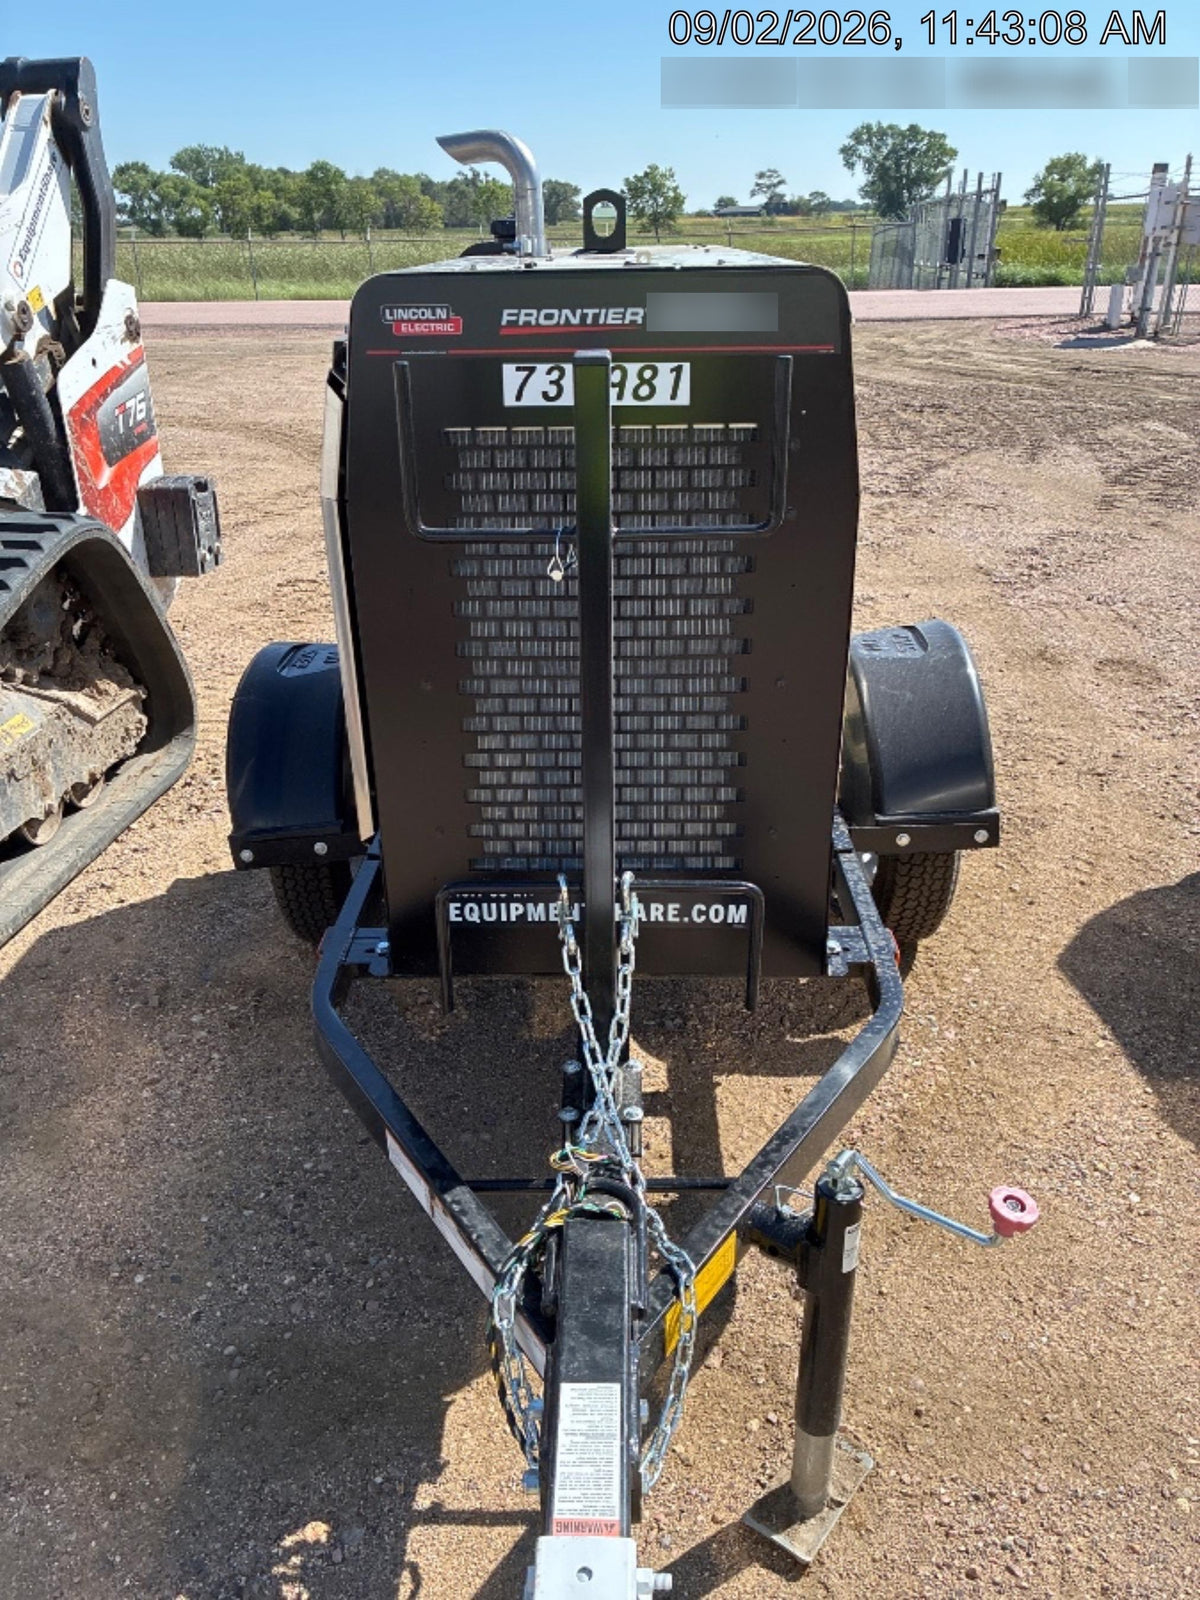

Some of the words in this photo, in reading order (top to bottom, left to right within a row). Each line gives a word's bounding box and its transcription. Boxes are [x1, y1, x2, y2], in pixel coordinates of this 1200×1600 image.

[19, 150, 58, 263] EquipmentShare
[384, 307, 448, 320] LINCOLN
[500, 307, 645, 326] FRONTIER
[400, 322, 455, 333] ELECTRIC
[514, 364, 684, 402] 73981
[555, 1520, 604, 1534] WARNING
